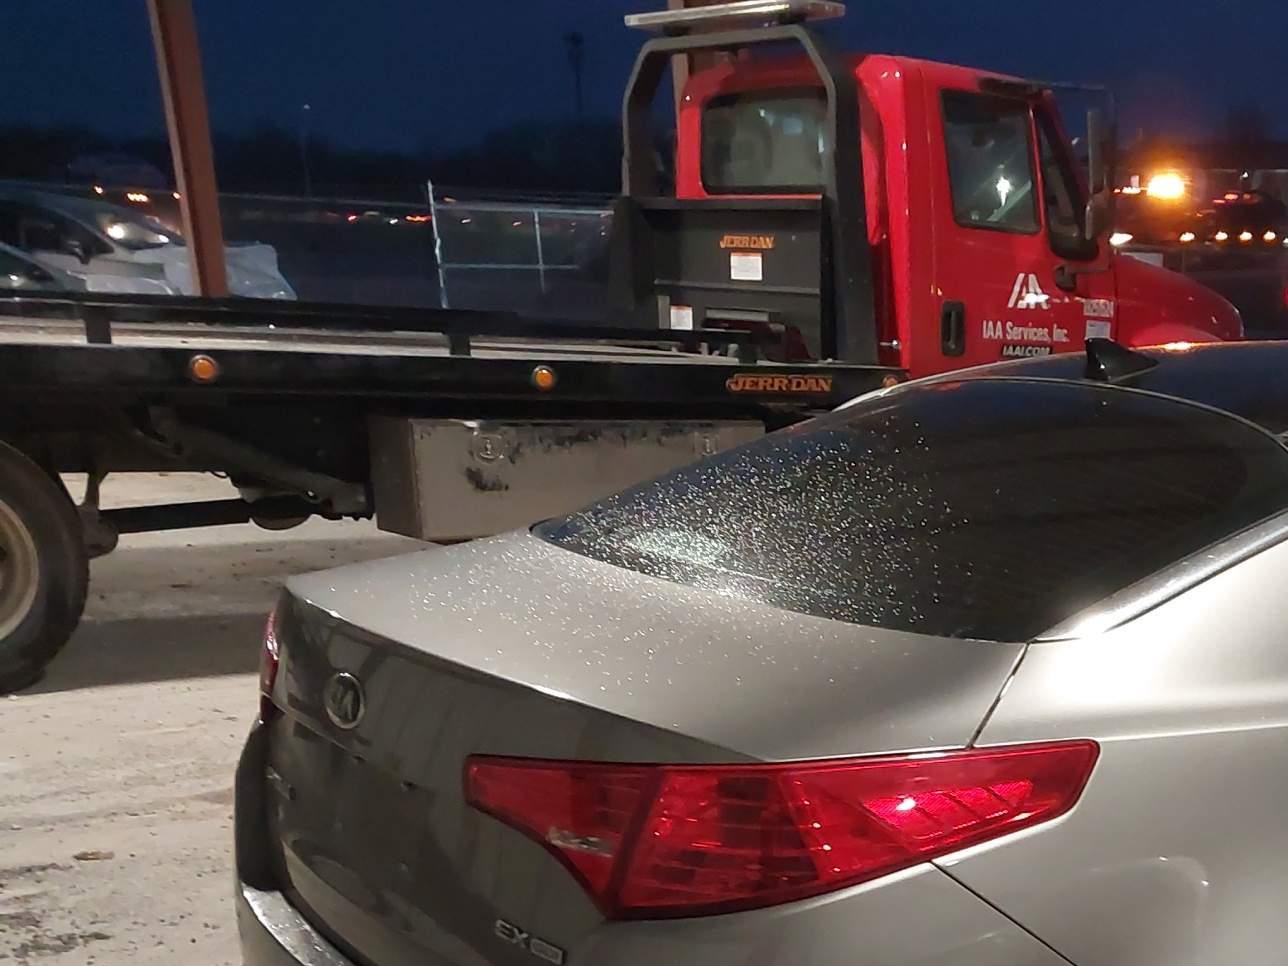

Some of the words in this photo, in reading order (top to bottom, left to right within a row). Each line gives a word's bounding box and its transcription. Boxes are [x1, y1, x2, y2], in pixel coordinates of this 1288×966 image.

[983, 320, 1003, 340] IAA
[1006, 320, 1052, 344] Services,
[1053, 322, 1071, 342] Inc.
[494, 918, 529, 948] EX
